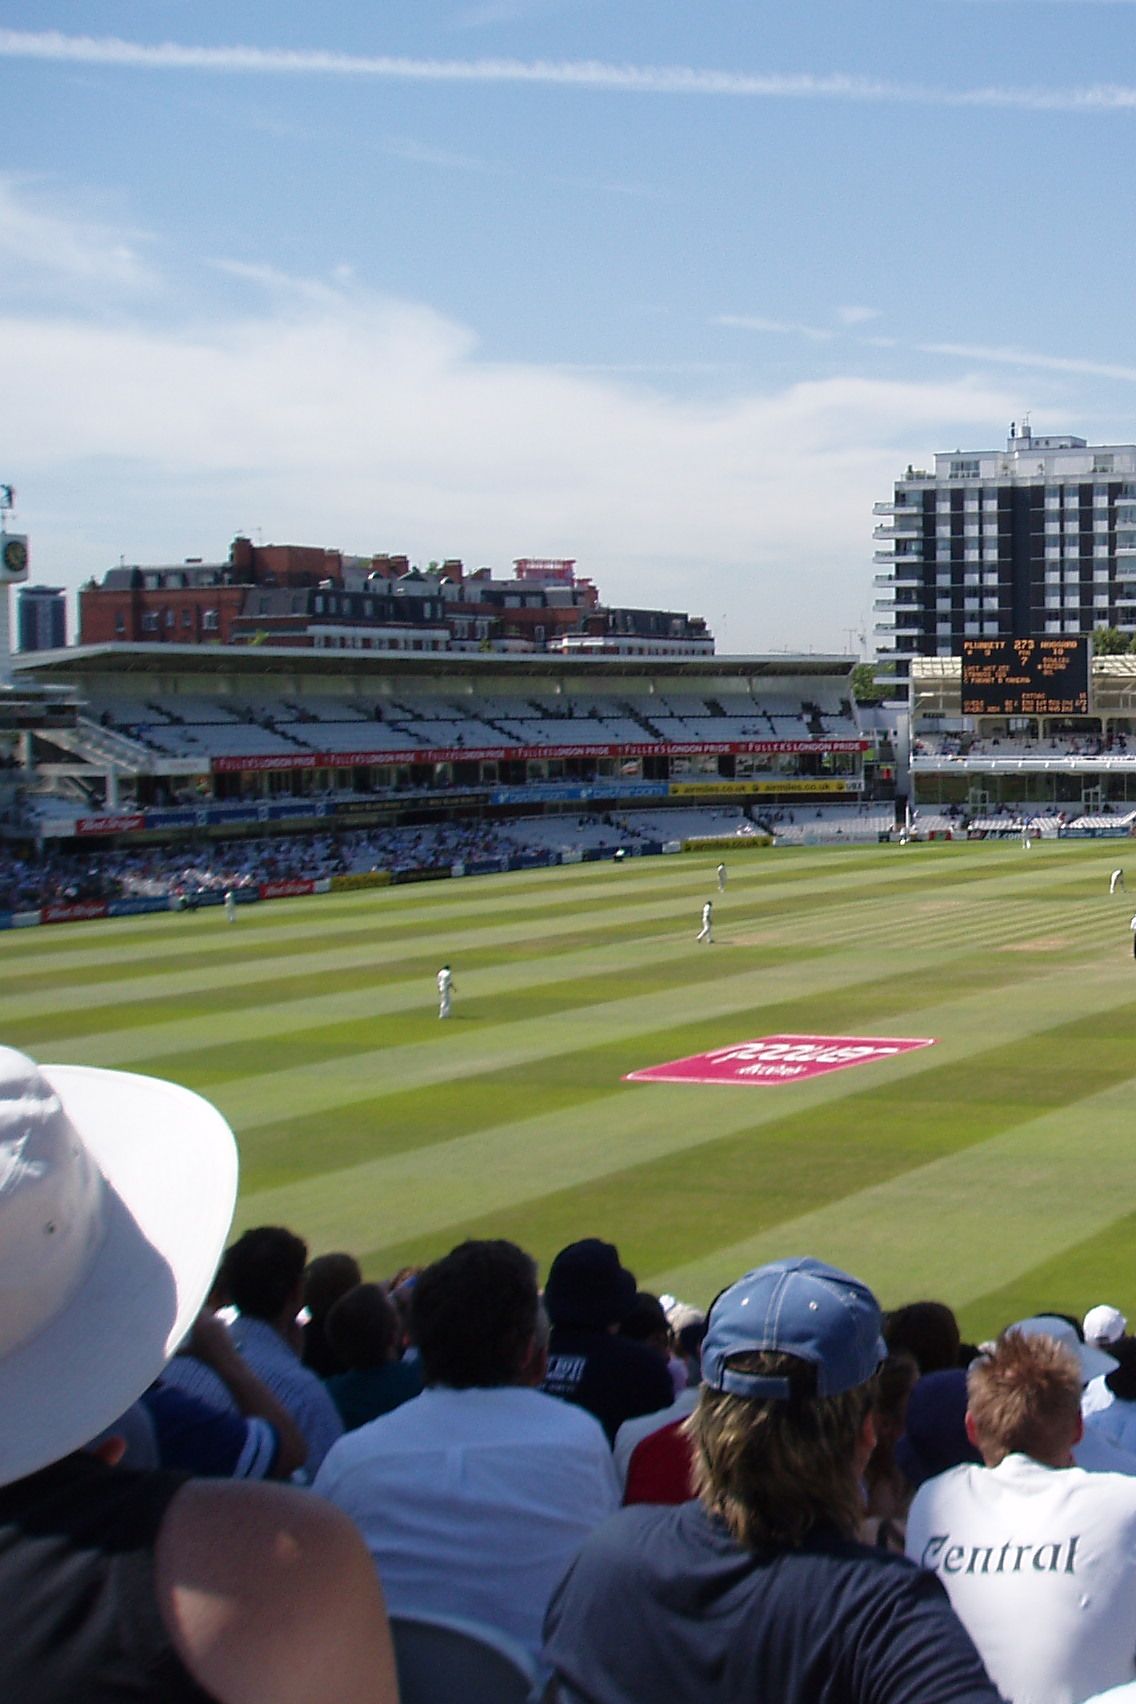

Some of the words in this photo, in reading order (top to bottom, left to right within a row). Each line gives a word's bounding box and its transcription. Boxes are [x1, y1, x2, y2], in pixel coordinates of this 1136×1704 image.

[1013, 640, 1035, 650] 273
[794, 742, 832, 751] LONDON
[833, 741, 861, 750] PRIDE
[765, 782, 830, 792] airmiles.co.uk
[921, 1534, 1081, 1575] Central
